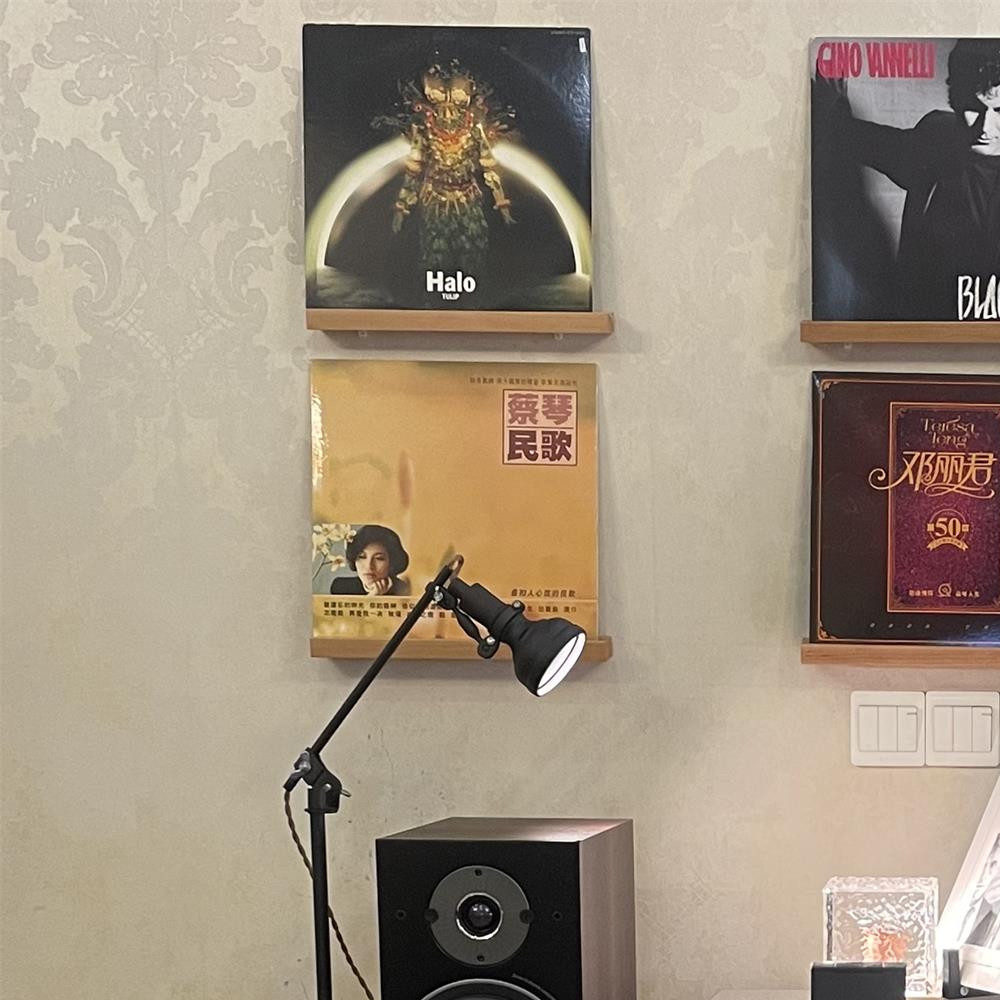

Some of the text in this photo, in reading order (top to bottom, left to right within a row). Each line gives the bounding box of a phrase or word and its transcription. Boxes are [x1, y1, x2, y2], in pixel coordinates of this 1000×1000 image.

[817, 42, 862, 79] GINO
[426, 270, 476, 293] Halo
[507, 393, 573, 425] 蔡琴
[507, 429, 572, 462] 民歌
[868, 450, 998, 499] 邓丽君
[935, 517, 961, 537] 50
